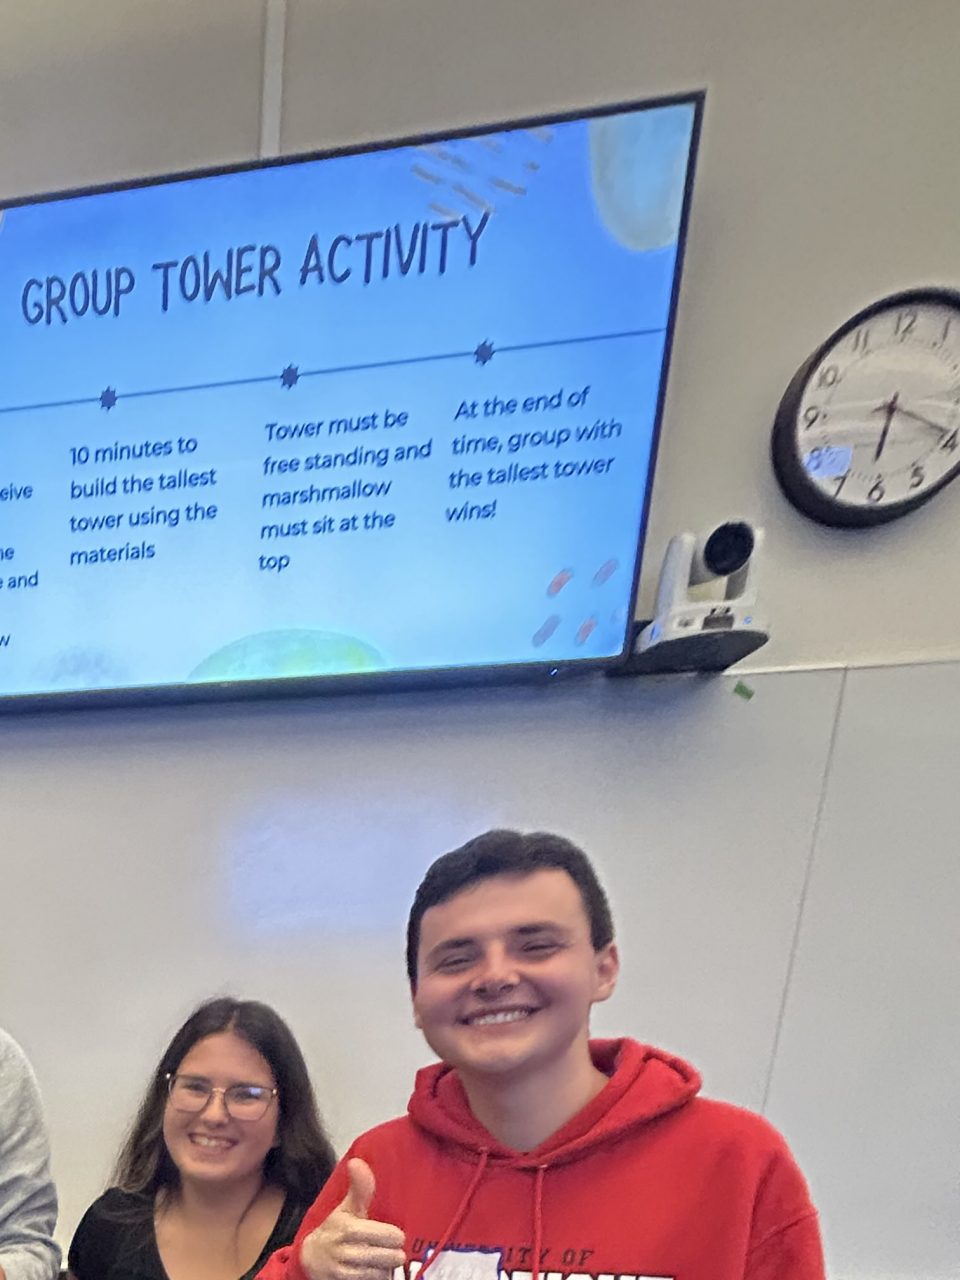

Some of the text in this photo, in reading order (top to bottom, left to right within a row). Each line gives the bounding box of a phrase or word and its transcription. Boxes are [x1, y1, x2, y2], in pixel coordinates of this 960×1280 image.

[21, 210, 491, 326] GROUP TOWER ACTIVITY
[893, 311, 917, 338] 12
[853, 328, 870, 351] 11
[817, 365, 839, 390] 10
[454, 385, 591, 421] At the end of
[265, 409, 408, 442] Tower must be
[803, 405, 820, 430] 9
[451, 418, 623, 455] time, group with
[940, 427, 960, 454] 4
[70, 436, 198, 466] 10 minutes to
[263, 437, 433, 476] free standing and
[70, 468, 217, 500] build the tallest
[448, 456, 616, 489] the tallest tower
[834, 468, 852, 499] 7
[909, 464, 925, 489] 5
[262, 479, 392, 509] marshmallow
[867, 479, 886, 502] 6
[70, 502, 218, 533] tower using the
[445, 499, 497, 522] wins!
[260, 510, 396, 540] must sit at the
[70, 541, 156, 566] materials
[259, 554, 290, 573] top
[8, 570, 38, 589] and
[561, 1248, 594, 1266] OF
